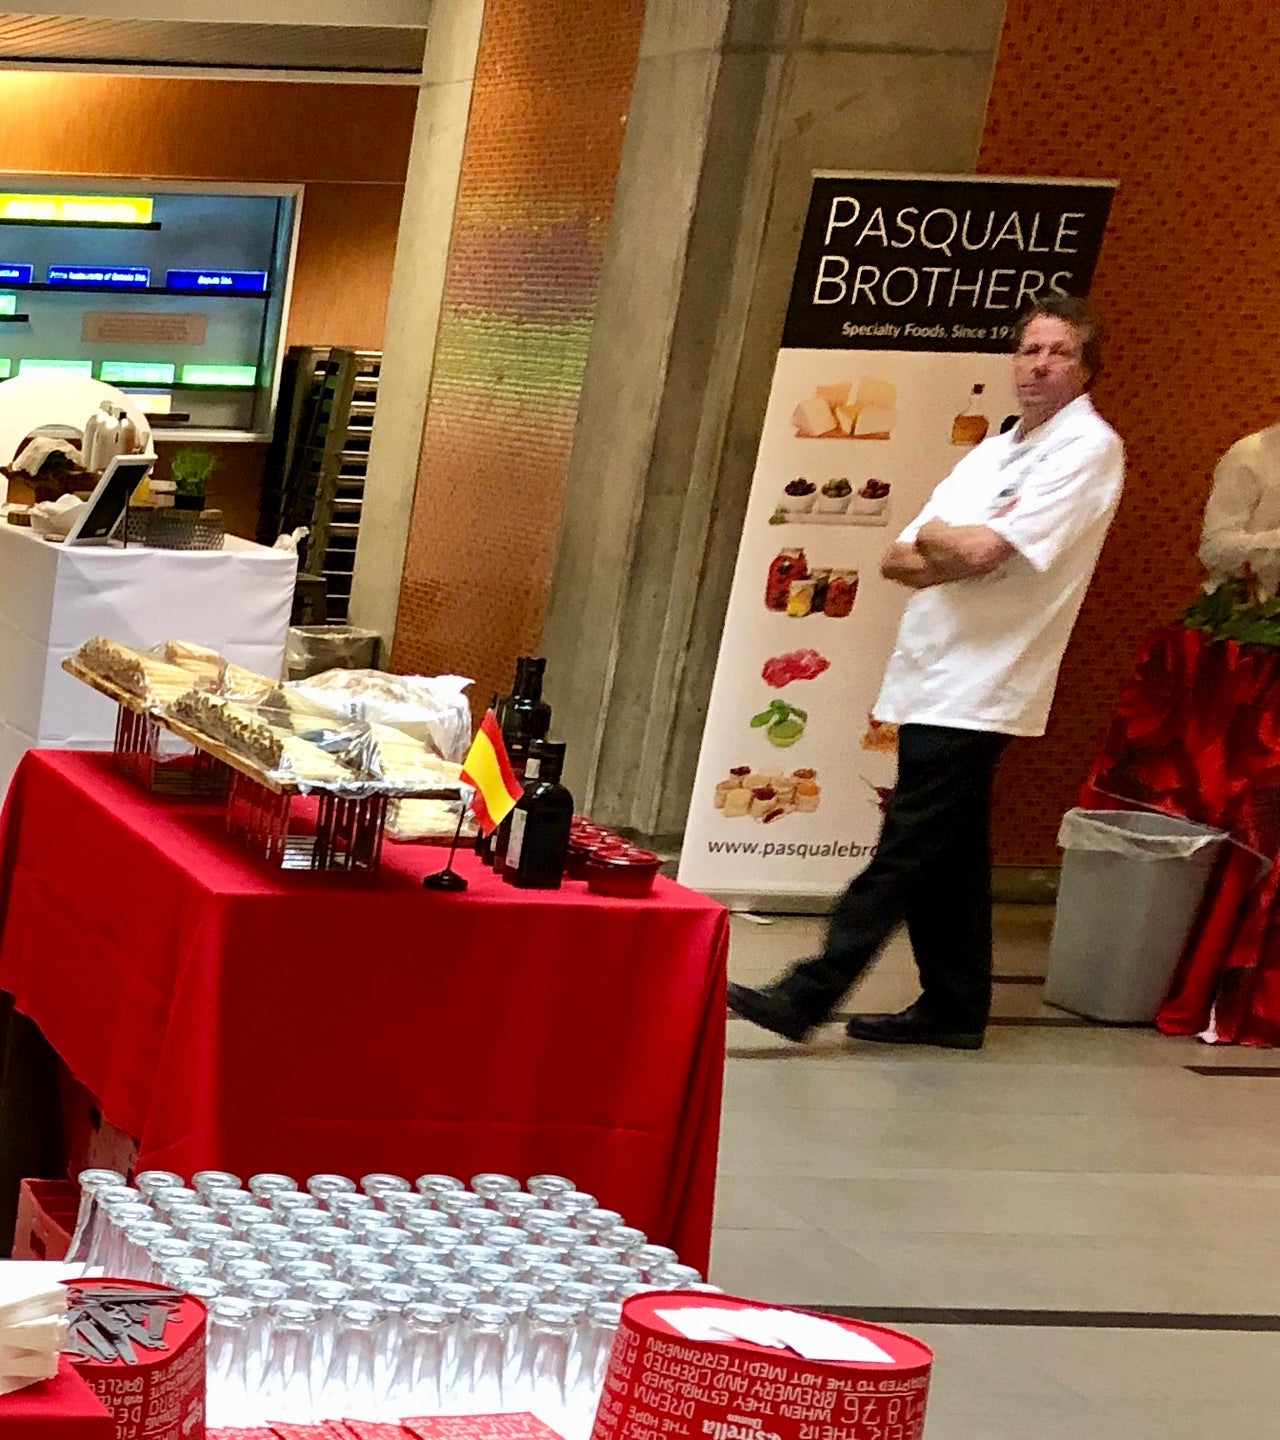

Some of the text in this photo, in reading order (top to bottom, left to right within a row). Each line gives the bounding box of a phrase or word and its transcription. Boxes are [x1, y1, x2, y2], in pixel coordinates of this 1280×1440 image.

[824, 196, 1086, 257] PASQUALE
[813, 255, 1074, 310] BROTHERS
[841, 321, 901, 338] Specialty
[952, 325, 987, 339] Since
